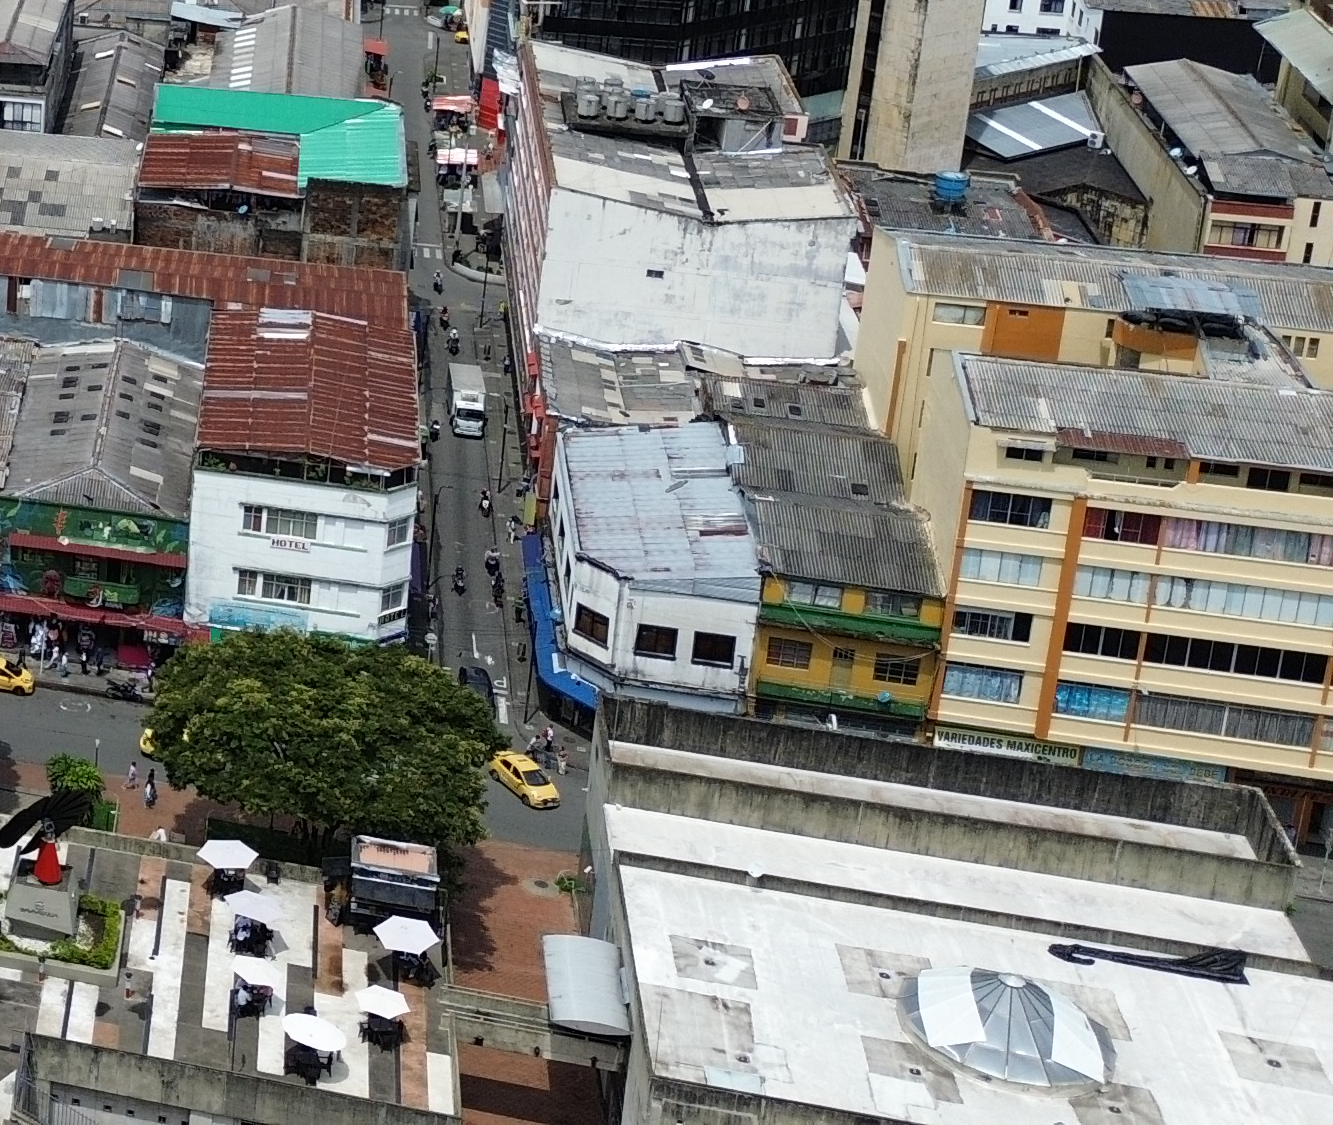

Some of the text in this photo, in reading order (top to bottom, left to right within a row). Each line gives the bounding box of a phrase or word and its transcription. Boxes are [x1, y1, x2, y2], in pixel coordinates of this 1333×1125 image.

[271, 538, 309, 551] HOTEL
[378, 610, 407, 626] HOTEL
[937, 730, 1078, 761] VARIEDADES MAXICENTRO
